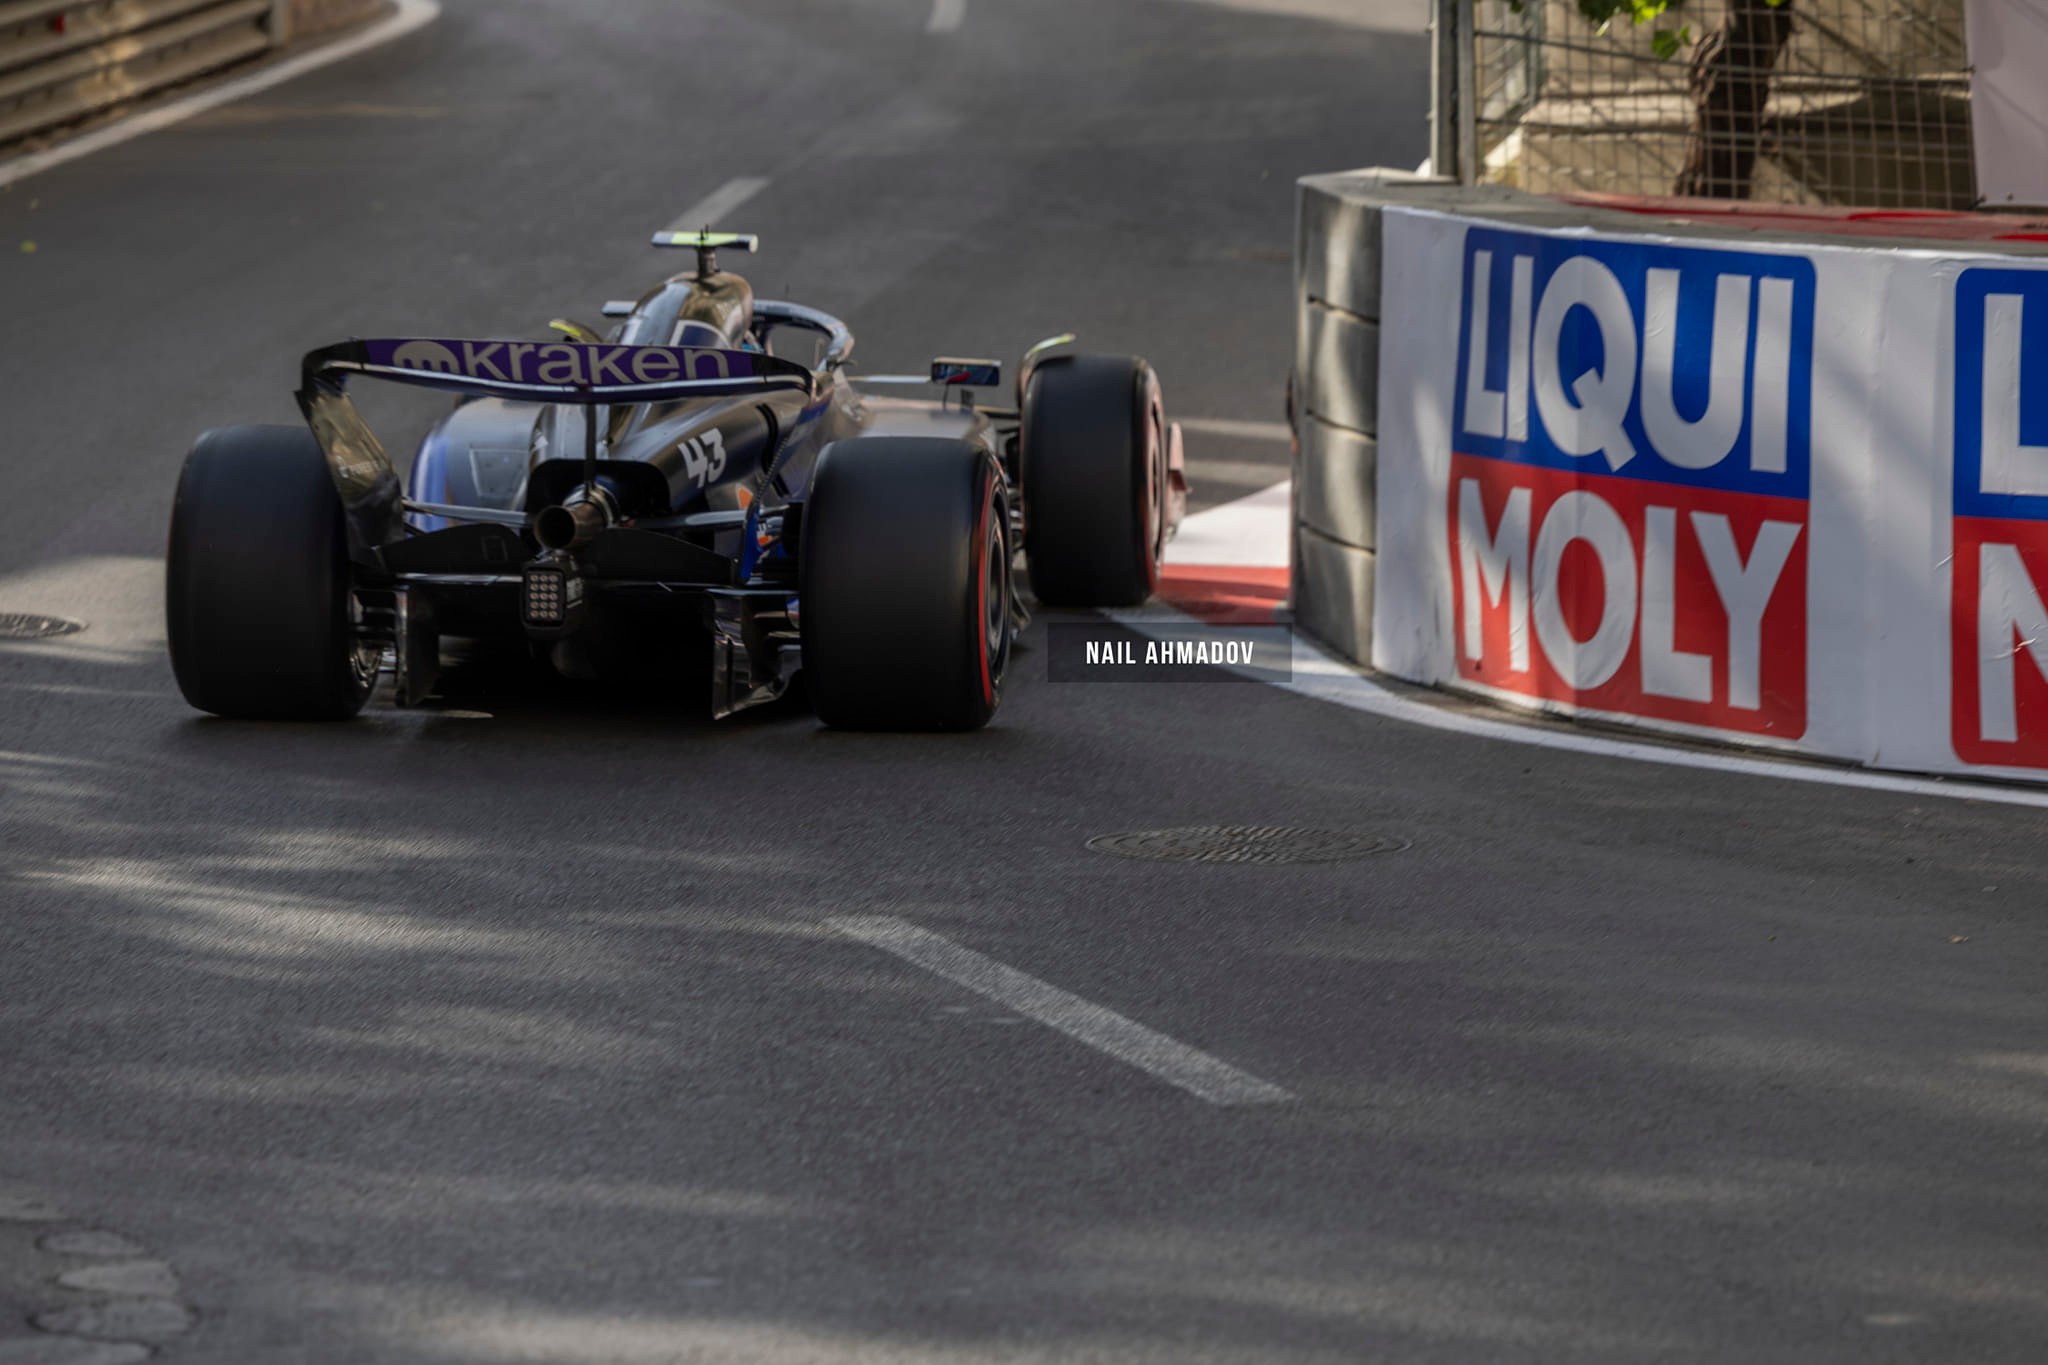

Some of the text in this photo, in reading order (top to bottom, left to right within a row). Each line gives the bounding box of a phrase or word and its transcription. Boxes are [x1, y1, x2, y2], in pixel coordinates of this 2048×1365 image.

[462, 341, 730, 385] kraken
[1463, 249, 1793, 474] LIQUI
[677, 427, 726, 489] 43
[1457, 477, 1804, 712] MOLY
